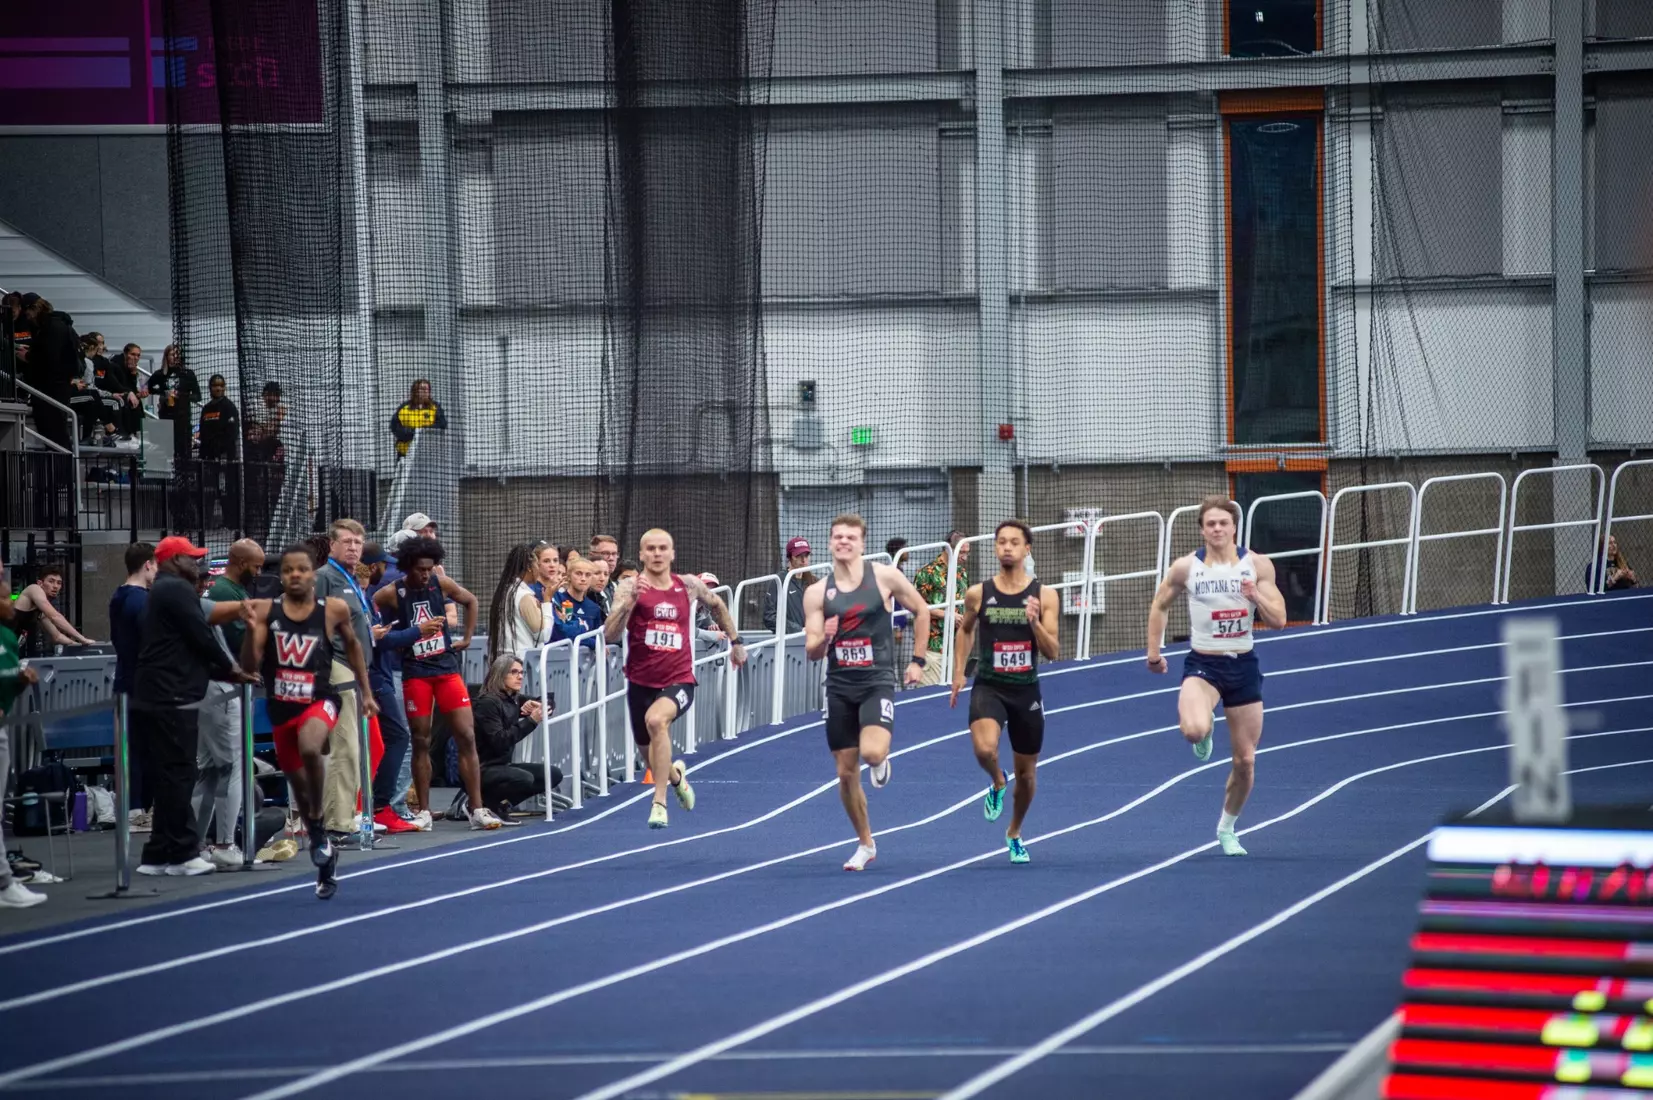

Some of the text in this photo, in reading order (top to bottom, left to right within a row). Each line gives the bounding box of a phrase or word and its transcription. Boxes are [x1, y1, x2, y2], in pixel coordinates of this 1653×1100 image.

[1195, 580, 1229, 594] MONTANA
[655, 607, 677, 618] CWU
[1219, 619, 1242, 633] 571
[418, 639, 439, 653] 147
[653, 632, 675, 647] 191
[274, 631, 318, 668] W
[842, 647, 866, 660] 869
[1000, 652, 1026, 666] 649
